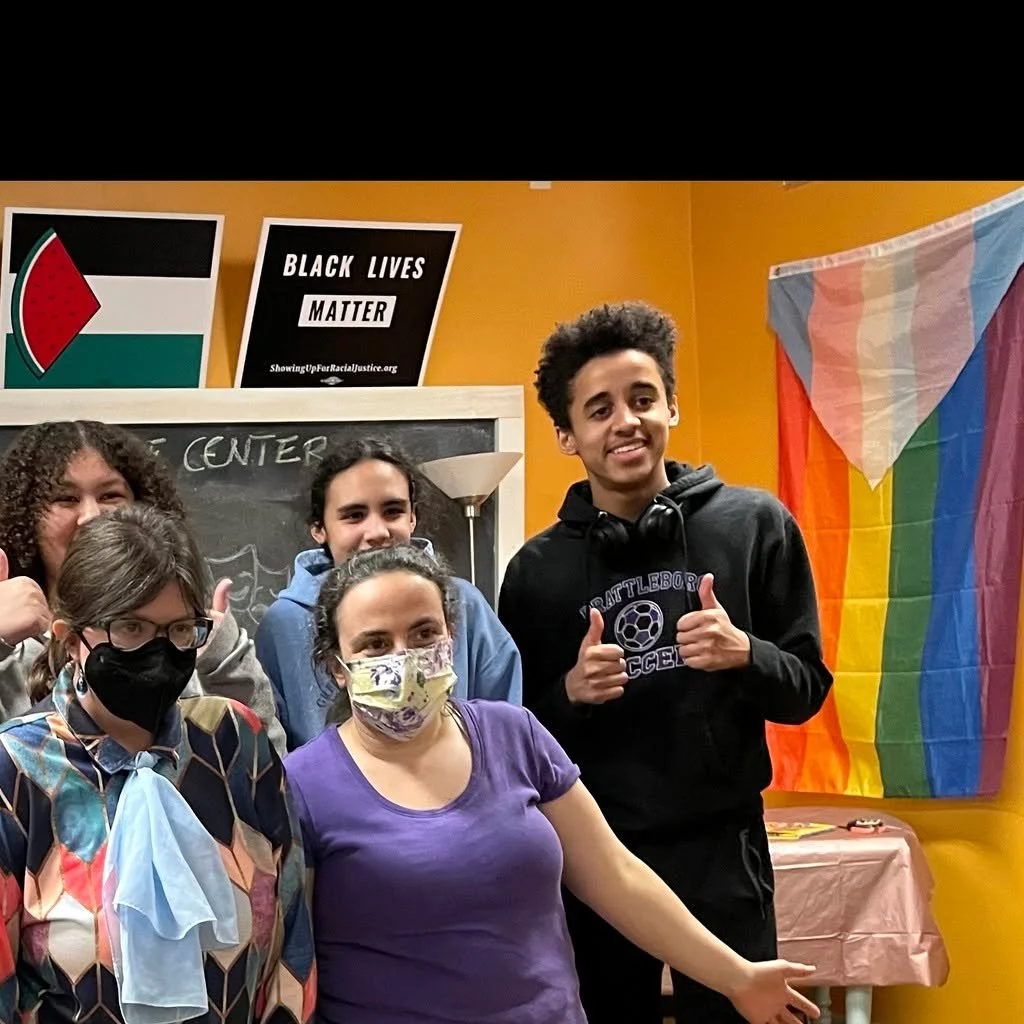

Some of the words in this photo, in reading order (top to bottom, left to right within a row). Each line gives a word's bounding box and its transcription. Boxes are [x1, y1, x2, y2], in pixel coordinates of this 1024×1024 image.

[282, 253, 354, 278] BLACK
[367, 256, 426, 279] LIVES
[308, 300, 388, 322] MATTER
[269, 363, 398, 374] ShowingUpForRacialJustice.org
[183, 434, 327, 472] CENTER
[579, 571, 705, 619] RATTLEBOR
